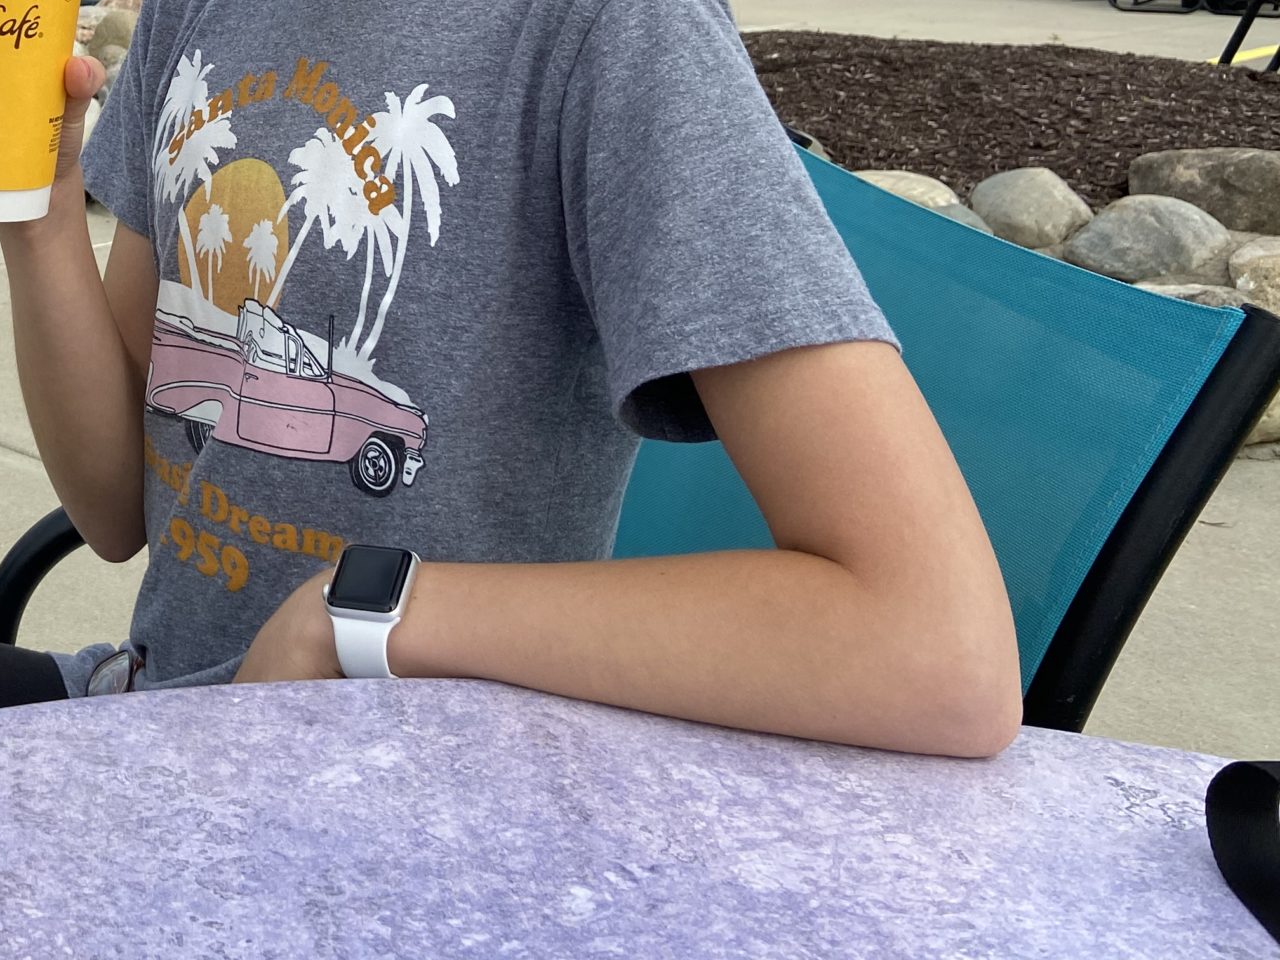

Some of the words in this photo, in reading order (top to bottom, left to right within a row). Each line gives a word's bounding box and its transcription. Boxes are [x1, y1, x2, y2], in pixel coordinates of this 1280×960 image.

[168, 70, 279, 167] Santa
[284, 55, 396, 216] Monica
[160, 516, 250, 592] 959
